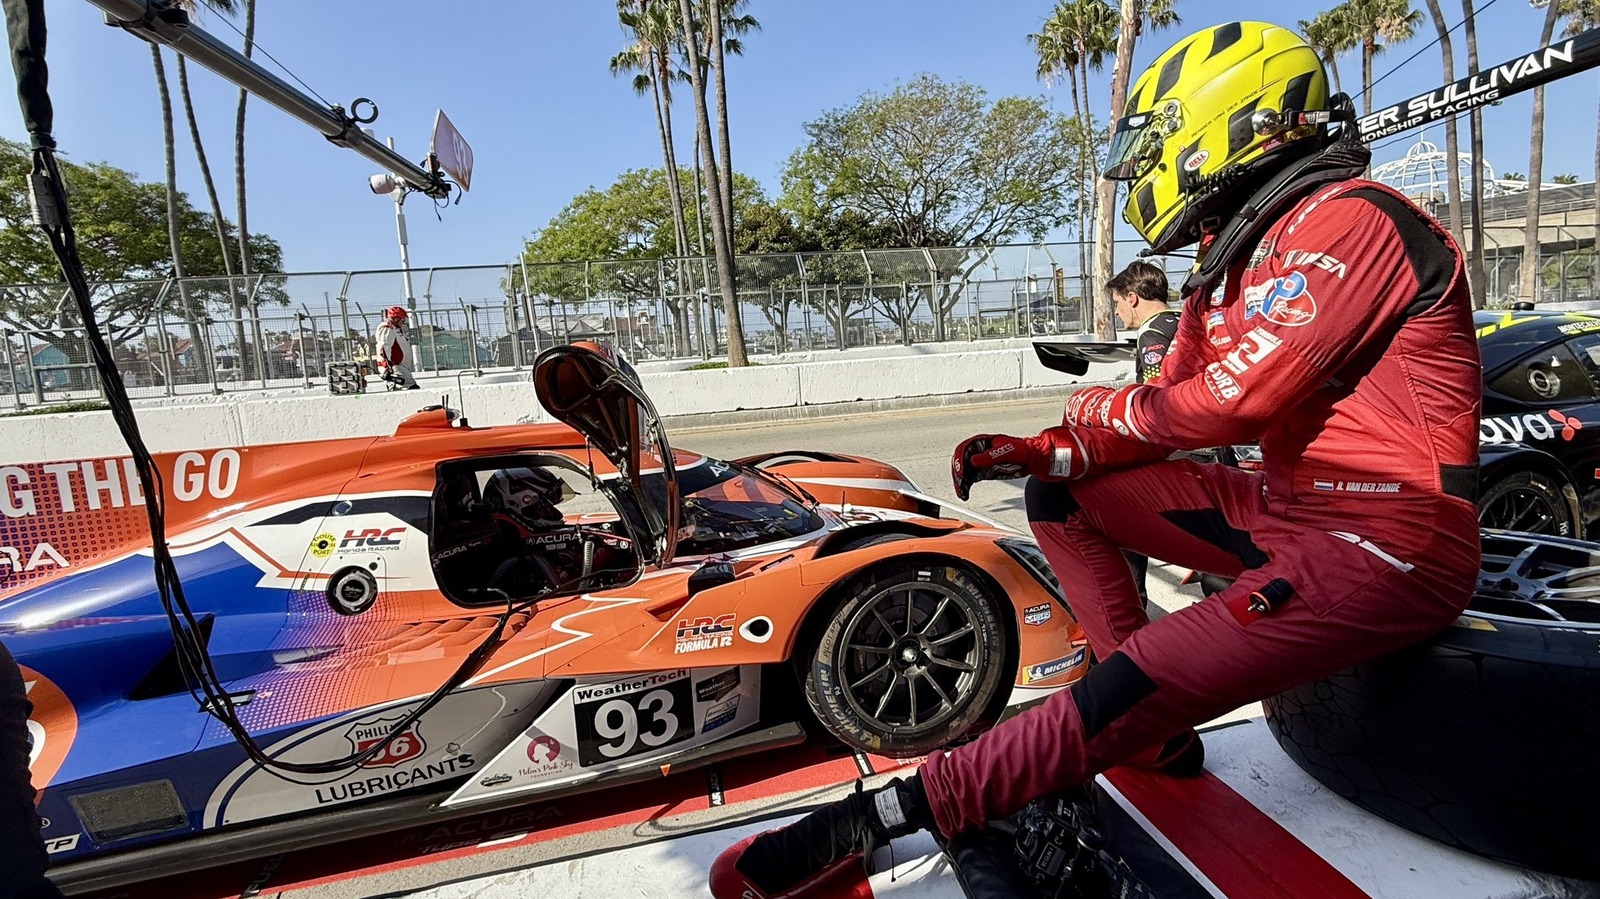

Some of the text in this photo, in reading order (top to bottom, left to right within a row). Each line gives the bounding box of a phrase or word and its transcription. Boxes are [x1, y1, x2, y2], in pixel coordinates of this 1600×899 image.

[1357, 39, 1576, 134] ER SULLIVAN
[1360, 89, 1500, 144] IONSHIP RACING
[1188, 153, 1207, 169] BELL
[1272, 300, 1314, 321] Racing
[1206, 362, 1241, 400] CURB
[989, 443, 1014, 458] sparco
[173, 448, 241, 502] GO
[709, 459, 731, 478] AC
[1345, 482, 1360, 492] VAN
[1360, 482, 1377, 492] DER
[1375, 482, 1402, 493] ZANDE
[339, 526, 408, 548] HRC
[535, 532, 580, 545] ACURA
[437, 545, 468, 560] ACURA
[965, 581, 1001, 647] MICHELIN
[1029, 603, 1050, 613] ACURA
[676, 613, 736, 638] HRC
[674, 638, 718, 654] FORMULA
[822, 634, 834, 658] PILOT
[1043, 653, 1083, 675] MICHELIN
[576, 668, 687, 700] WeatherTech
[820, 669, 860, 735] MICHELIN
[355, 723, 412, 741] PHILL
[594, 689, 679, 758] 93
[518, 760, 574, 776] Helen's Pink Sky
[315, 755, 475, 804] LUBRICANTS
[422, 805, 564, 842] ACURA
